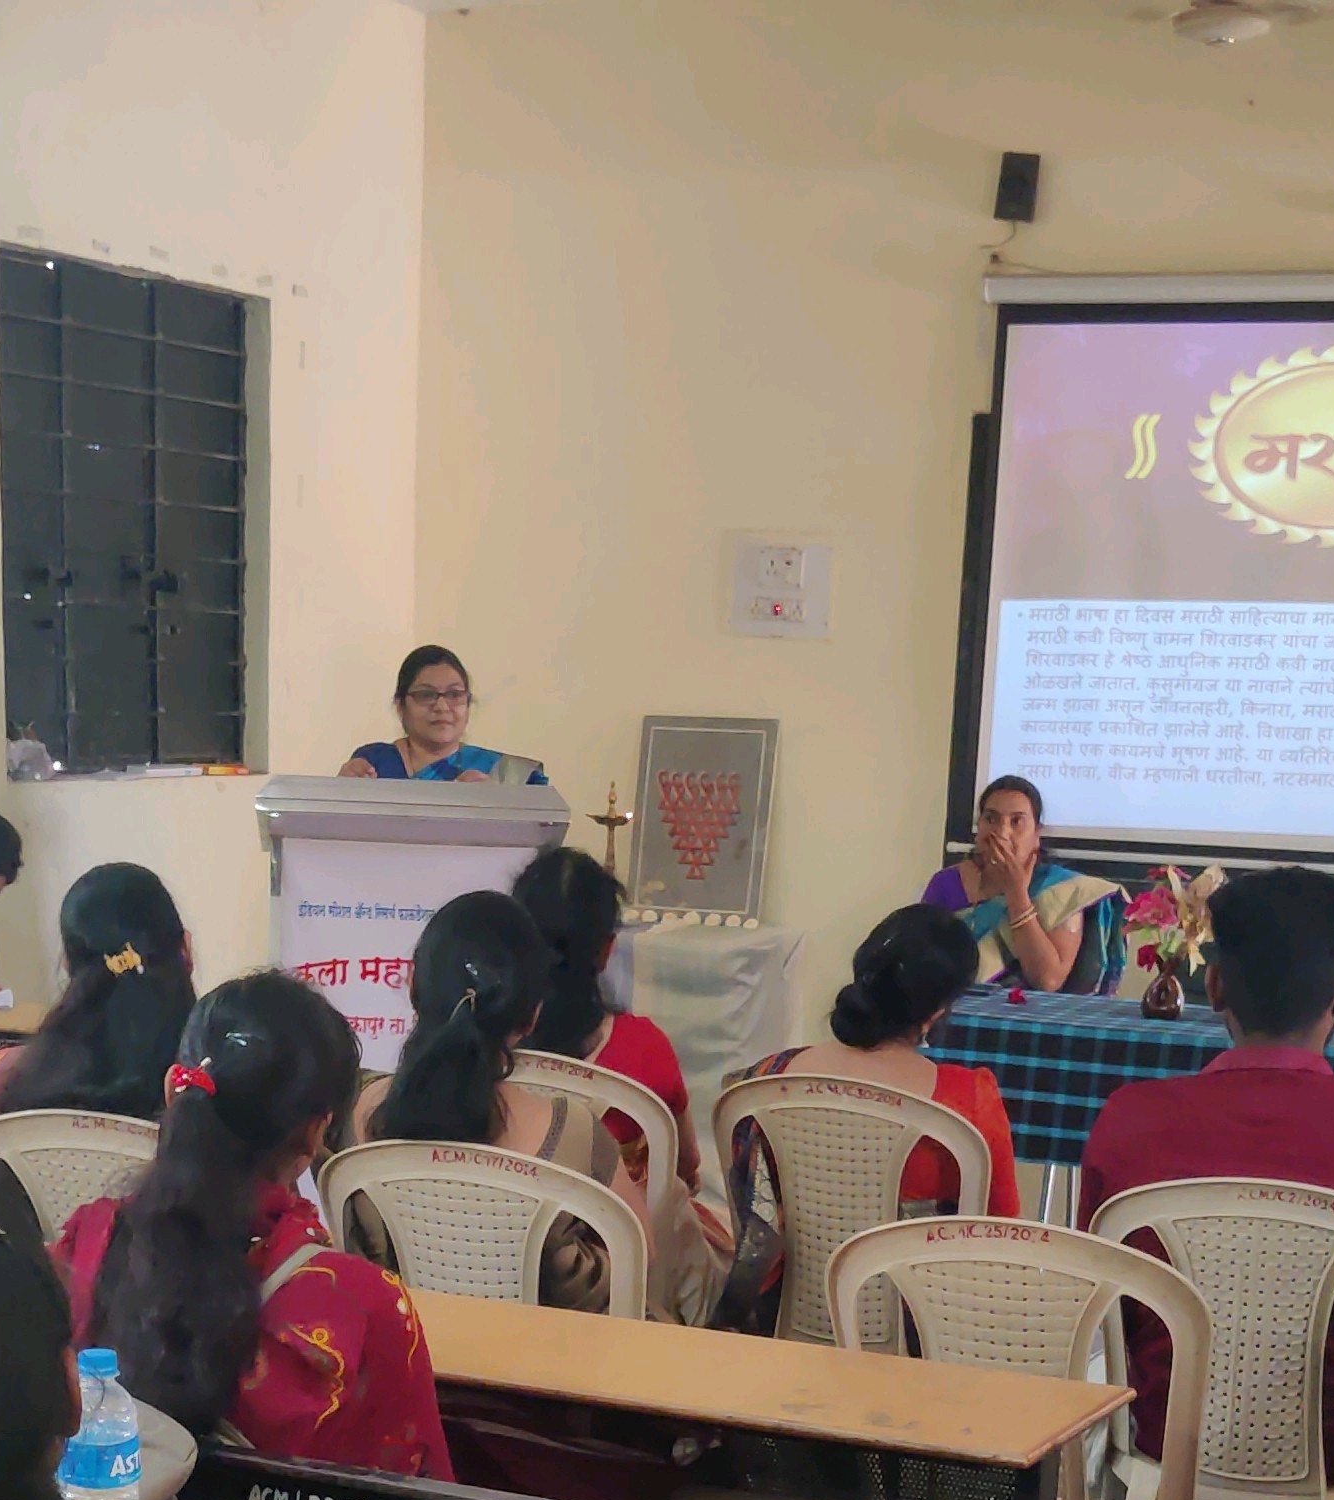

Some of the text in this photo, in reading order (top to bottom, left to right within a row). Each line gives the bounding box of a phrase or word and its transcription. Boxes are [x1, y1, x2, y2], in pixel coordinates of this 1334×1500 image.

[1029, 603, 1070, 622] मराठी
[1076, 609, 1109, 622] भाषा
[1114, 609, 1130, 624] हा
[1135, 605, 1175, 623] दिवस
[1180, 605, 1224, 624] मराठी
[1027, 626, 1069, 644] मराठी
[1074, 627, 1104, 644] कवी
[1153, 632, 1195, 646] वामन
[1200, 629, 1277, 648] शिरवाडकर
[1025, 649, 1100, 667] शिरवाडकर
[1104, 649, 1115, 669] हे
[1158, 651, 1223, 678] आधुनिक
[1227, 652, 1270, 670] मराठी
[1276, 654, 1307, 671] कवी
[1023, 671, 1084, 689] ओळखले
[1225, 680, 1242, 693] या
[1247, 676, 1294, 694] नावाने
[1317, 727, 1333, 743] हा
[1080, 743, 1104, 757] एक
[1257, 748, 1273, 763] या
